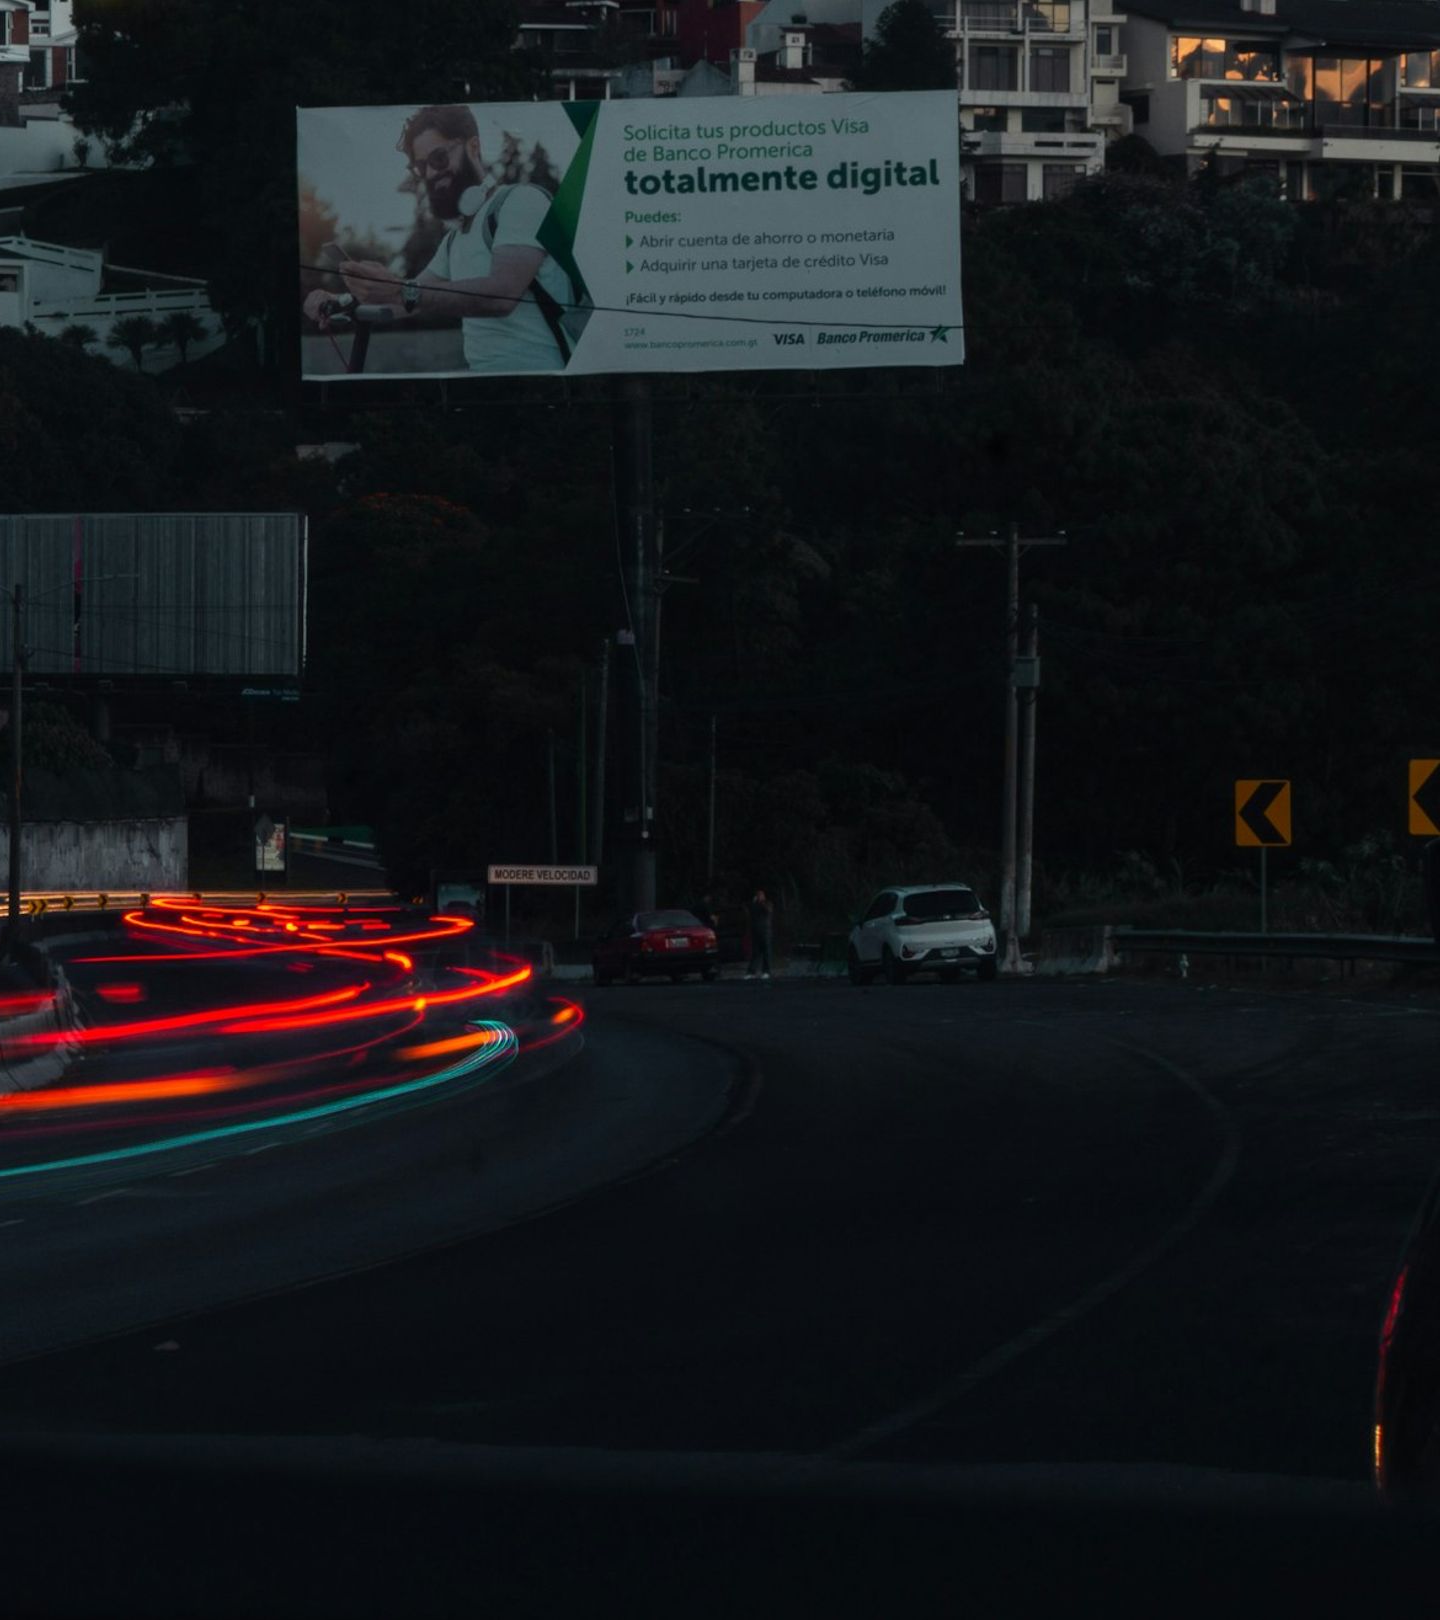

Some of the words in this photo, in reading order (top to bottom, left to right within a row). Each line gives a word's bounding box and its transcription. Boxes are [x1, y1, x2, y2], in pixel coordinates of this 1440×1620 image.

[624, 124, 691, 141] Solicita
[696, 124, 724, 139] tus
[730, 120, 826, 141] productos
[831, 118, 869, 134] Visa
[623, 146, 647, 163] de
[653, 145, 712, 162] Banco
[717, 142, 813, 160] Promerica
[624, 166, 818, 195] totalmente
[827, 158, 940, 195] digital
[625, 210, 681, 223] Puedes:
[639, 235, 675, 248] Abrir
[678, 234, 728, 248] cuenta
[732, 233, 750, 246] de
[754, 232, 803, 245] ahorro
[806, 234, 817, 244] o
[820, 228, 895, 243] monetaria
[640, 259, 697, 274] Adquirir
[701, 260, 728, 271] una
[732, 256, 778, 272] tarjeta
[782, 256, 801, 268] de
[803, 254, 856, 268] crédito
[859, 253, 889, 266] Visa
[659, 295, 666, 306] y
[668, 292, 707, 305] rápido
[708, 290, 745, 302] desde
[747, 291, 759, 301] tu
[762, 289, 843, 302] computadora
[845, 290, 854, 298] o
[856, 286, 907, 298] teléfono
[909, 285, 946, 296] móvil!
[773, 333, 805, 345] VISA
[816, 332, 857, 345] Banco
[858, 329, 926, 343] Promerica
[494, 869, 535, 880] MODERE
[536, 870, 591, 881] VELOCIDAD
